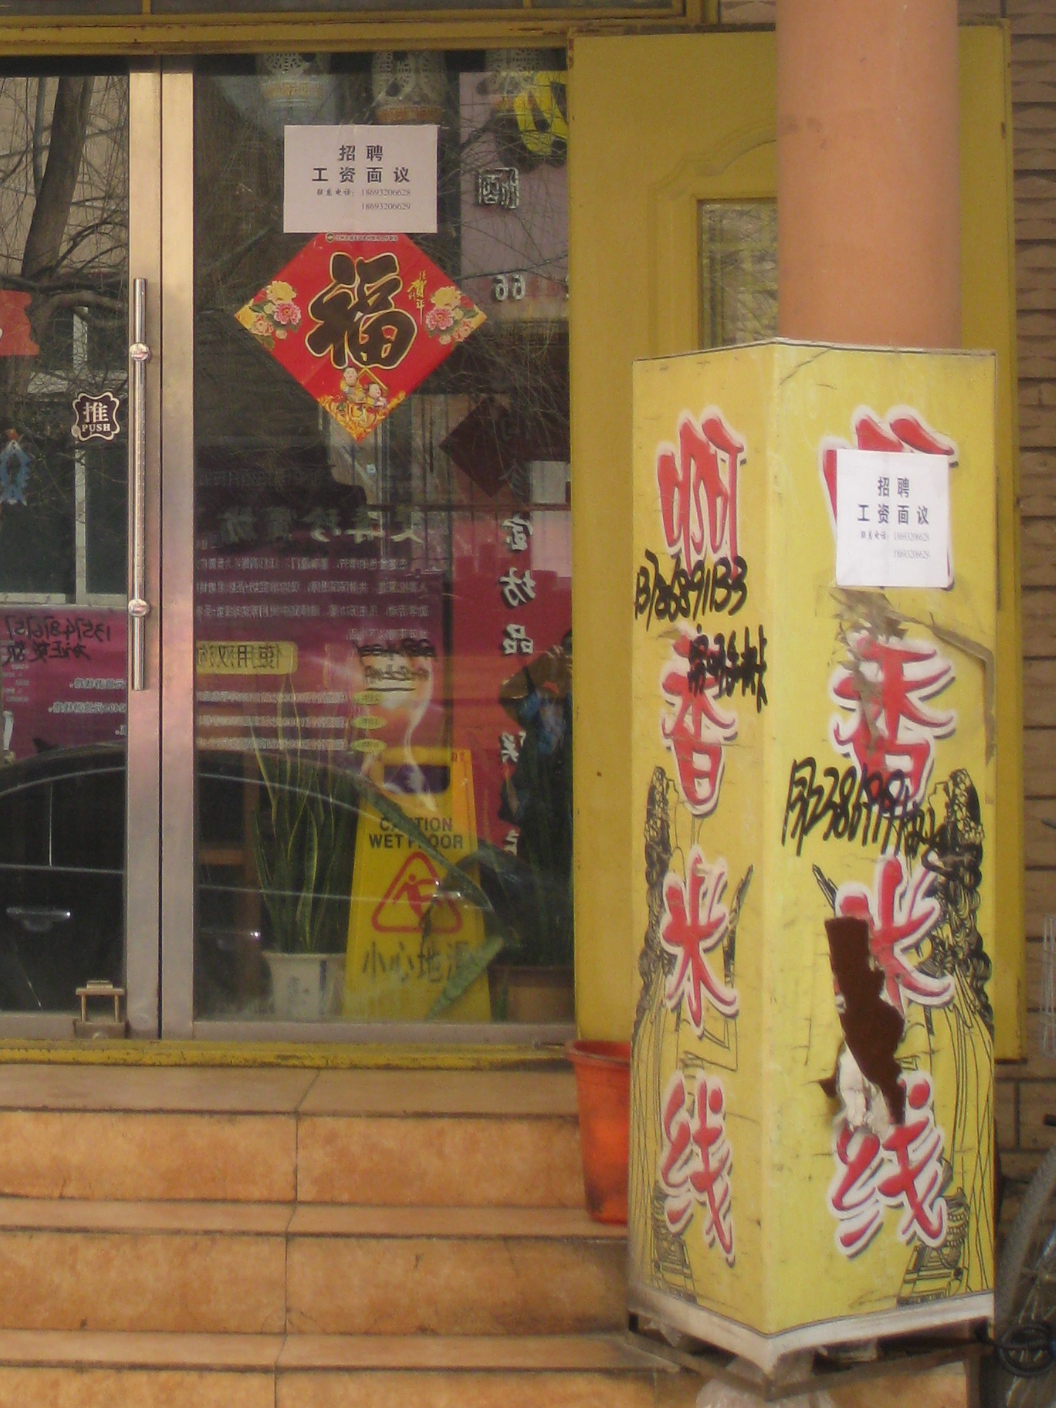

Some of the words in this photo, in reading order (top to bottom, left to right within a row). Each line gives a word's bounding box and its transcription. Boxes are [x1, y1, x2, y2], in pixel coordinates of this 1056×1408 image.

[337, 144, 384, 162] 招聘
[311, 166, 411, 184] 工资面议
[305, 252, 418, 370] 福
[83, 402, 109, 423] 推
[82, 423, 111, 432] PUSH
[877, 476, 910, 498] 招聘
[857, 503, 929, 525] 工资面议
[369, 834, 404, 849] WET
[407, 833, 464, 849] FOOR
